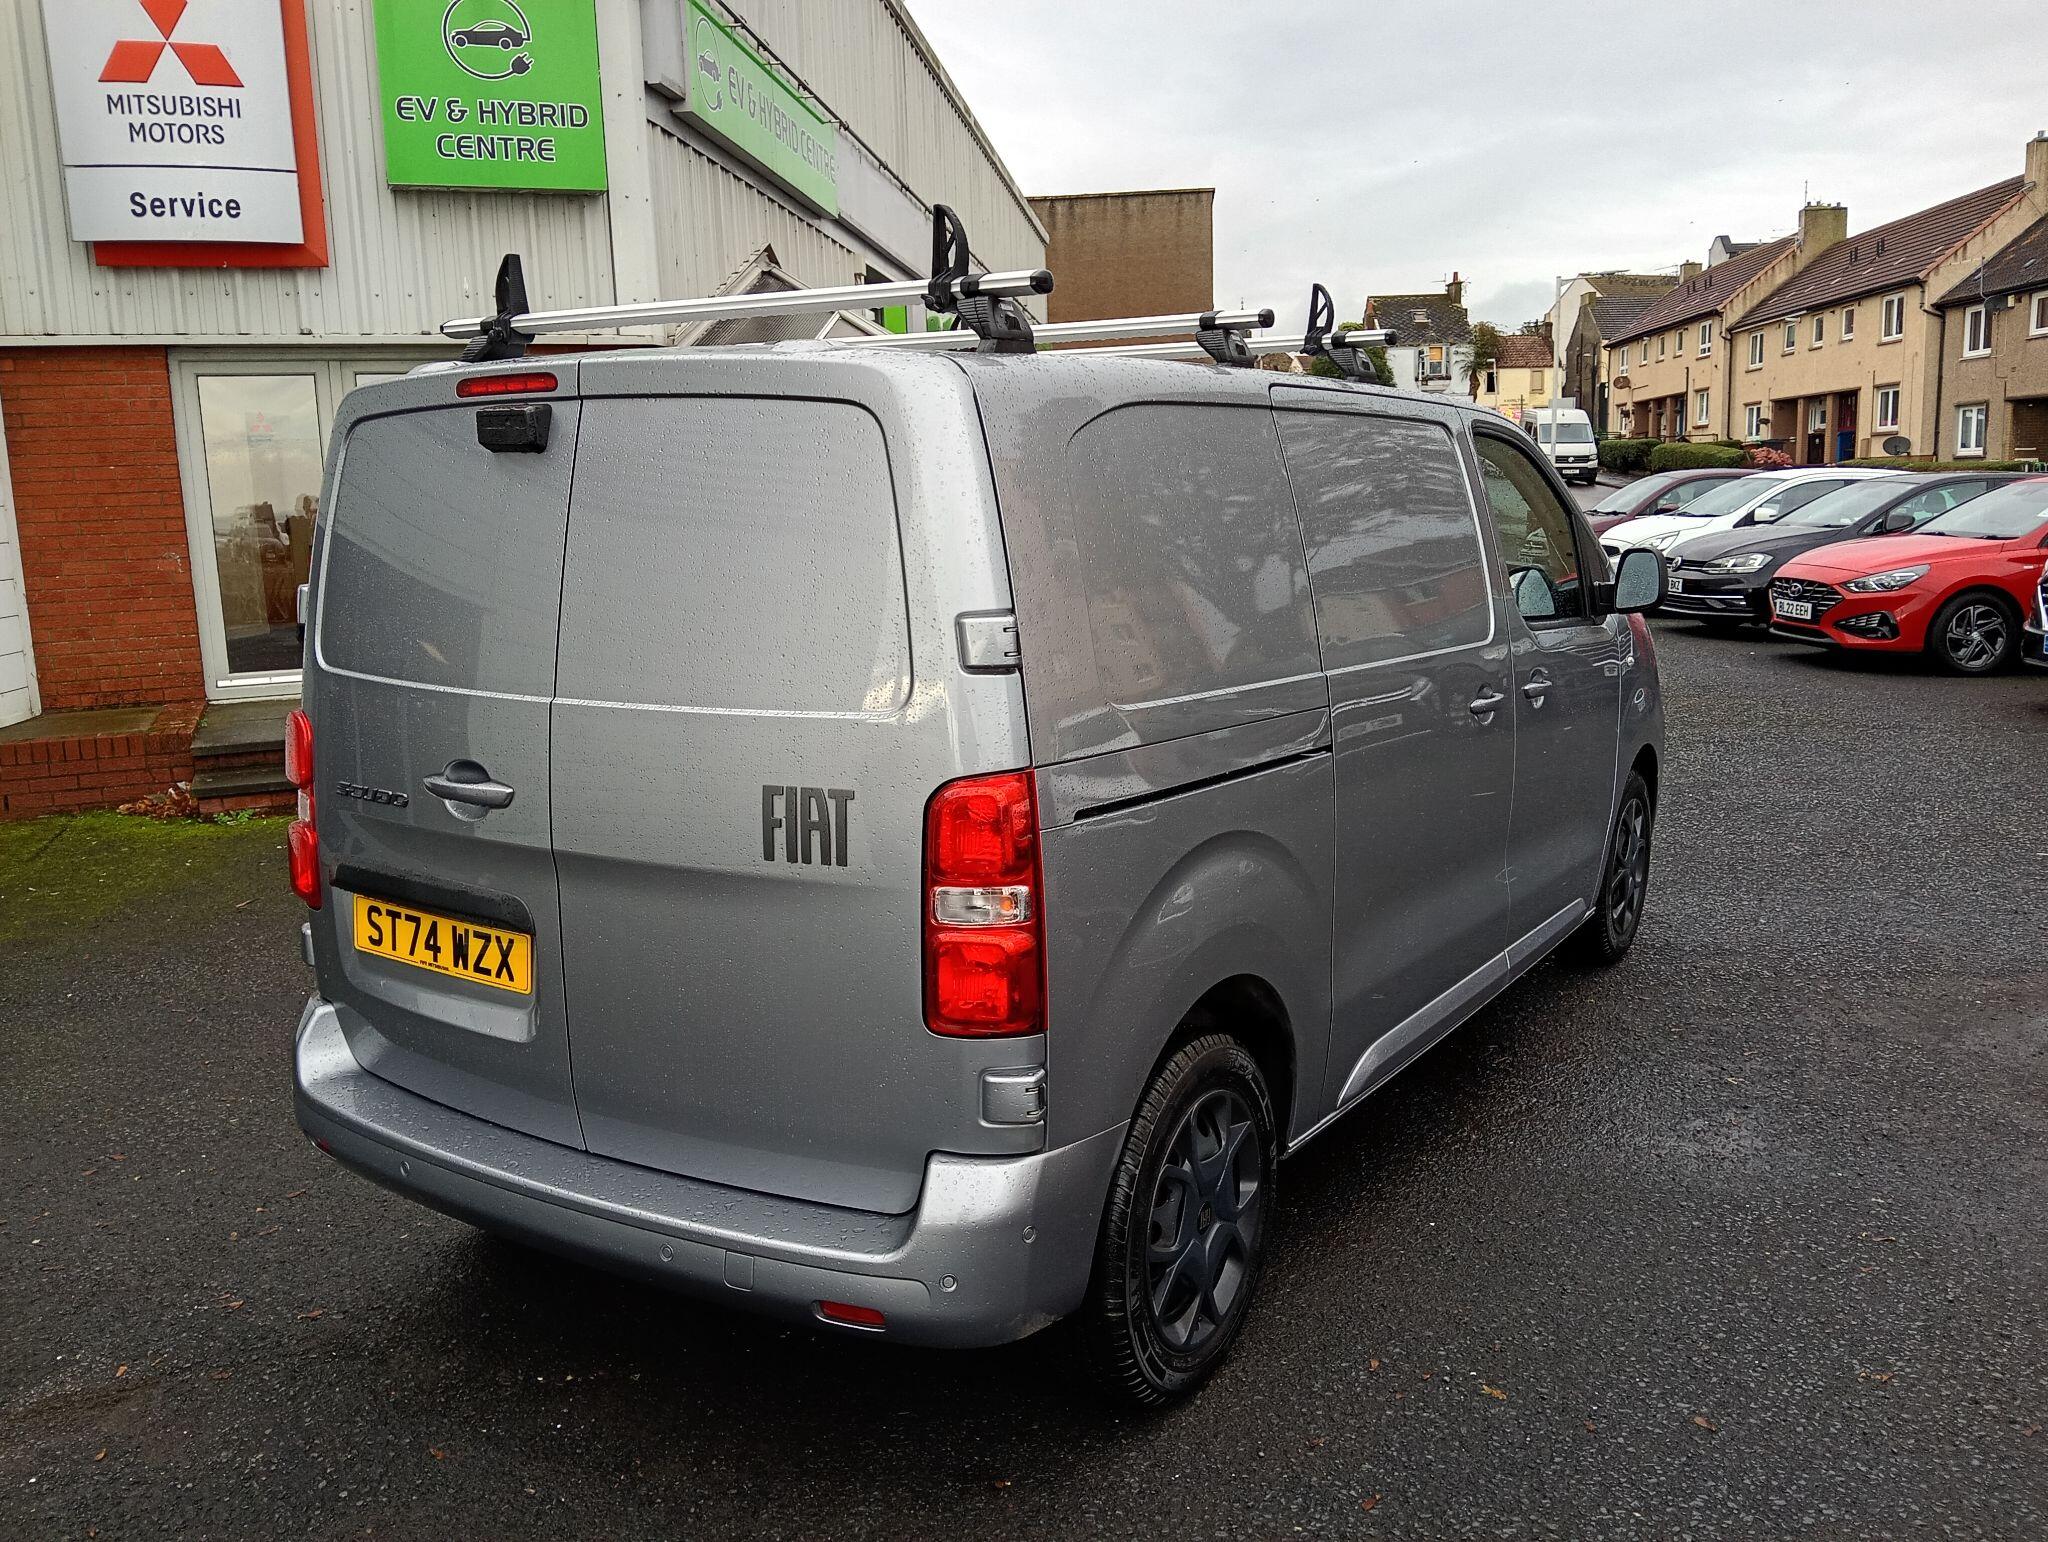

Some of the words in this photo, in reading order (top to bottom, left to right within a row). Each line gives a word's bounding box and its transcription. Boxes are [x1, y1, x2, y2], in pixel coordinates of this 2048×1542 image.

[106, 94, 242, 119] MITSUBISHI
[396, 96, 438, 122] EV
[446, 98, 468, 123] &
[478, 100, 589, 130] HYBRID
[128, 121, 225, 146] MOTORS
[728, 64, 745, 111] EV
[748, 81, 757, 122] &
[759, 91, 800, 155] HYBRID
[800, 129, 837, 185] CENTRE
[436, 134, 557, 163] CENTRE
[129, 191, 242, 220] Service
[1778, 600, 1795, 614] BL22
[1795, 603, 1809, 617] EEH
[336, 780, 409, 808] SCUDO
[762, 784, 855, 867] FIAT
[366, 904, 442, 963] ST74
[451, 925, 515, 982] WZX
